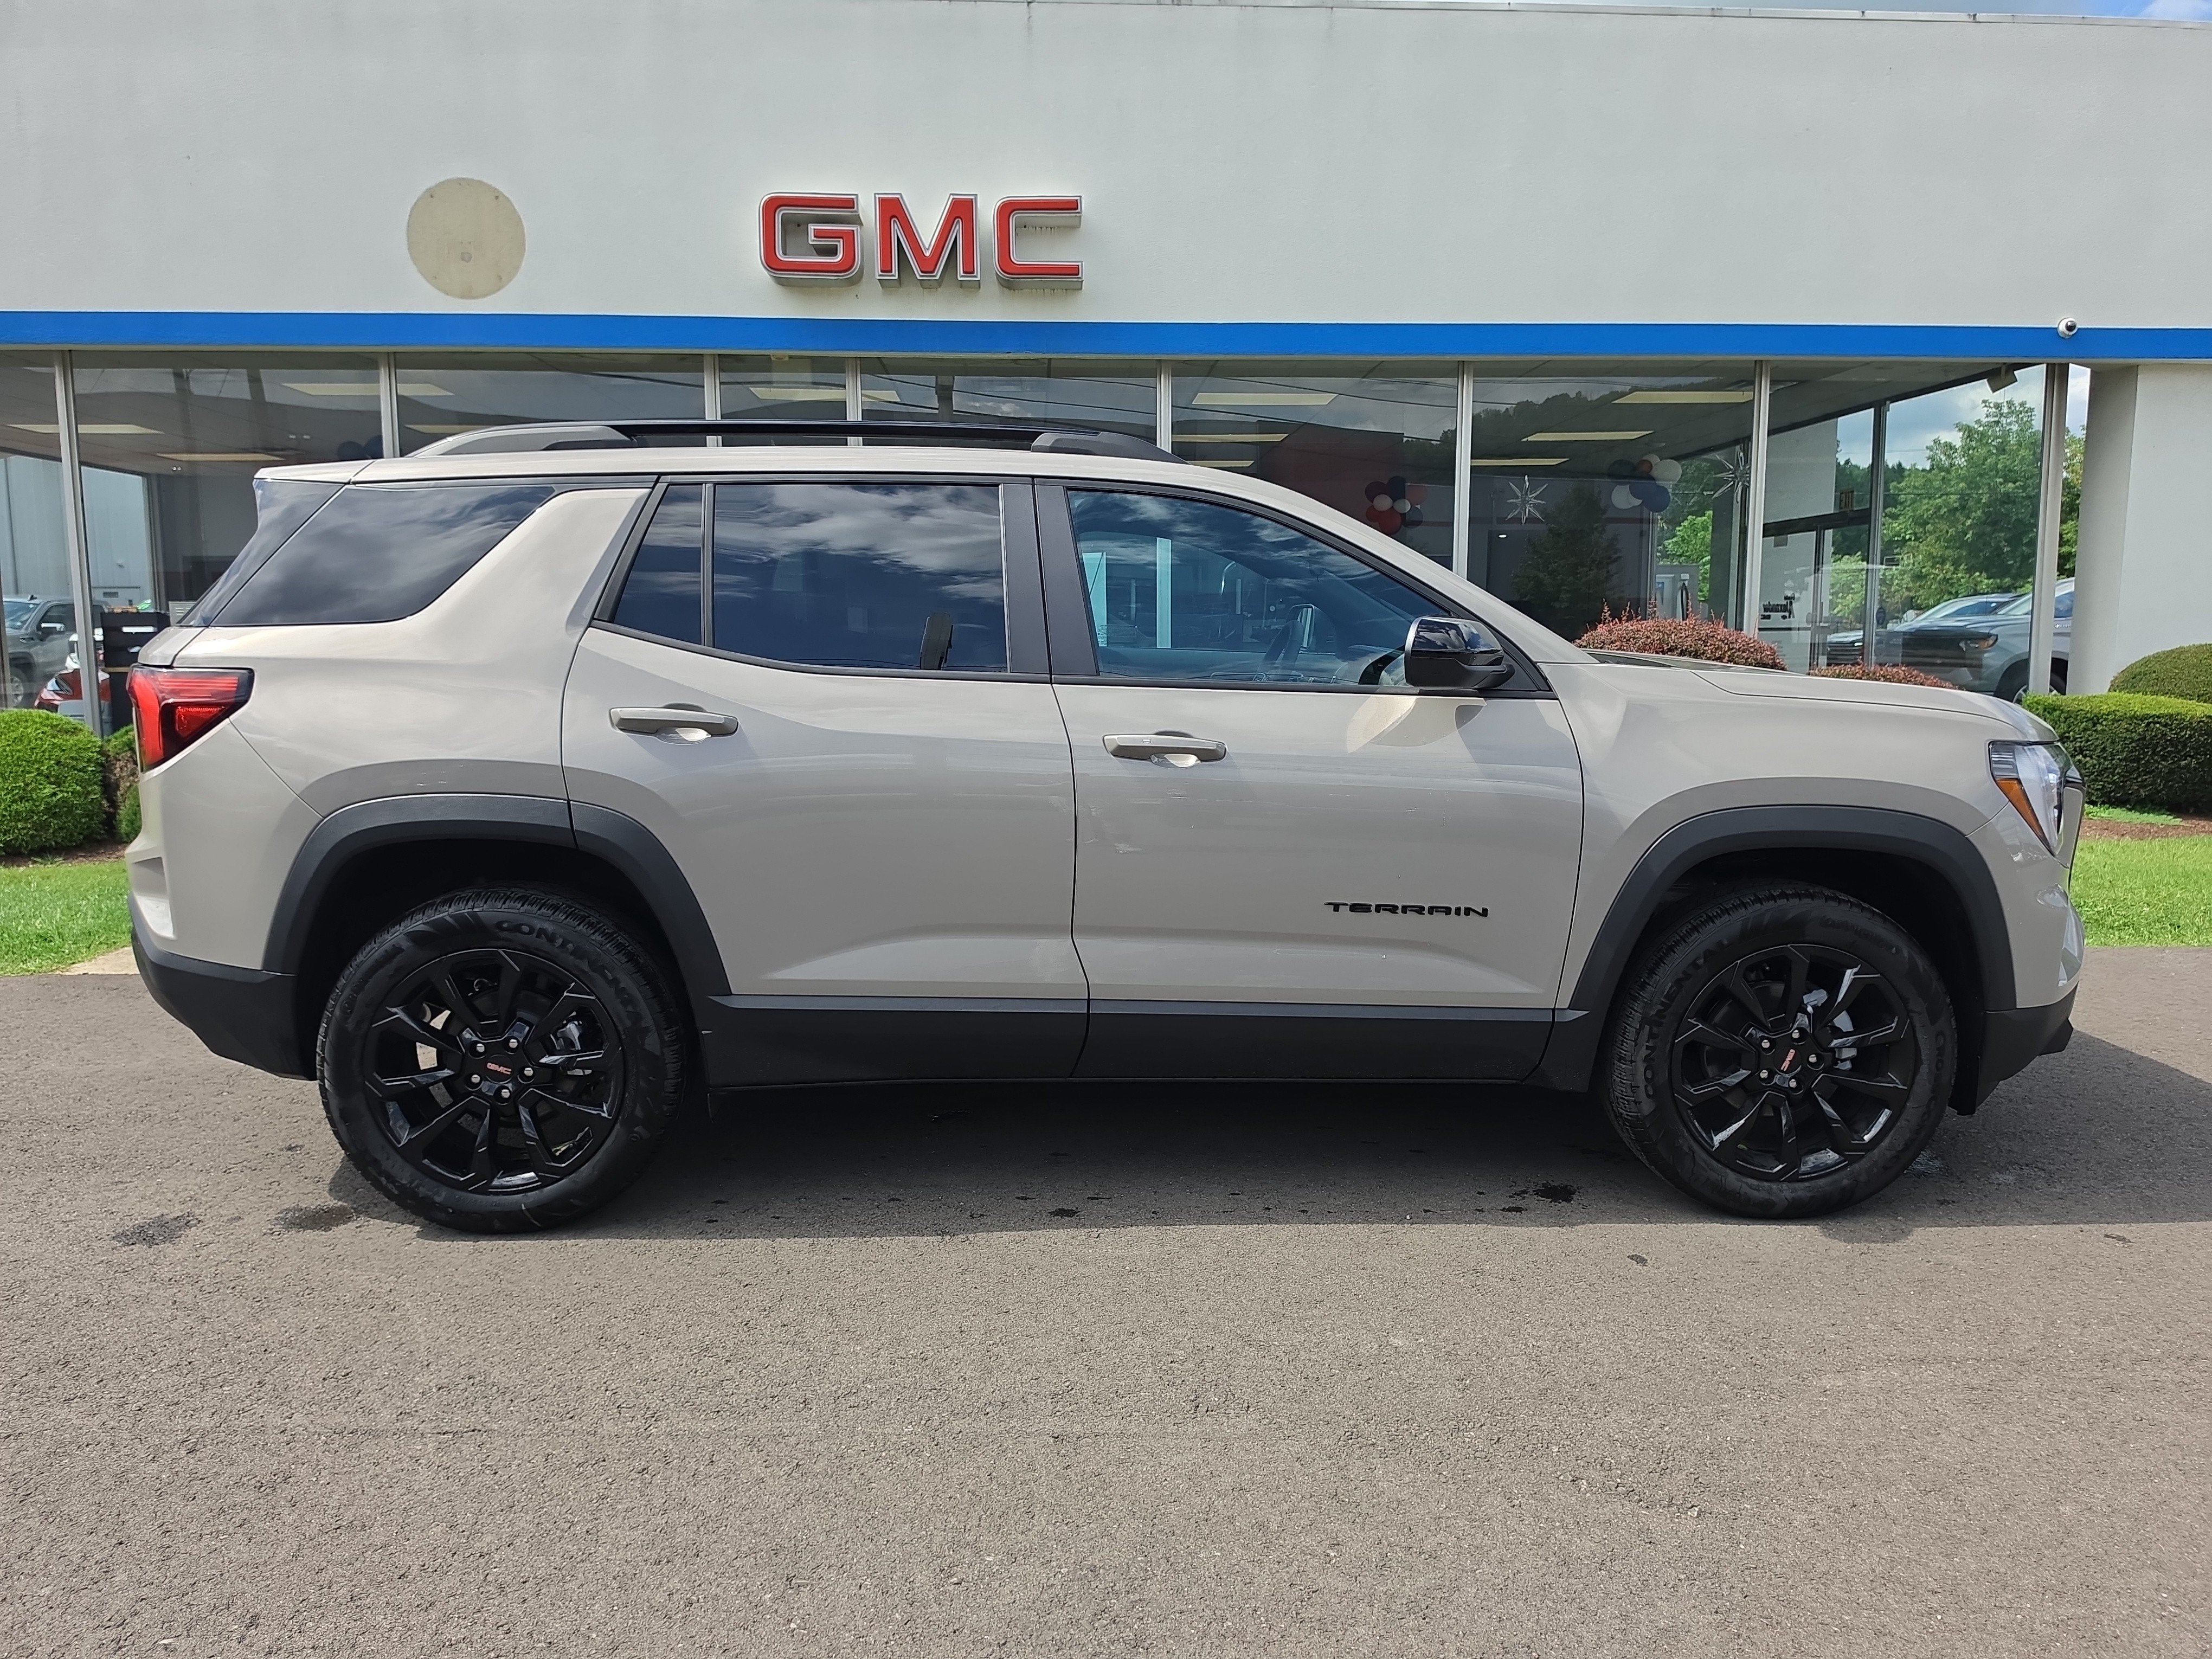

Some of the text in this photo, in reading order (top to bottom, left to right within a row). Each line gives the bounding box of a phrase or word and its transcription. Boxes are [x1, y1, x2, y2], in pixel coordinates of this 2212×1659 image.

[759, 192, 1084, 282] GMC
[1324, 902, 1489, 918] TERRAIN
[487, 1062, 512, 1075] GMC
[1780, 1049, 1796, 1071] GMC
